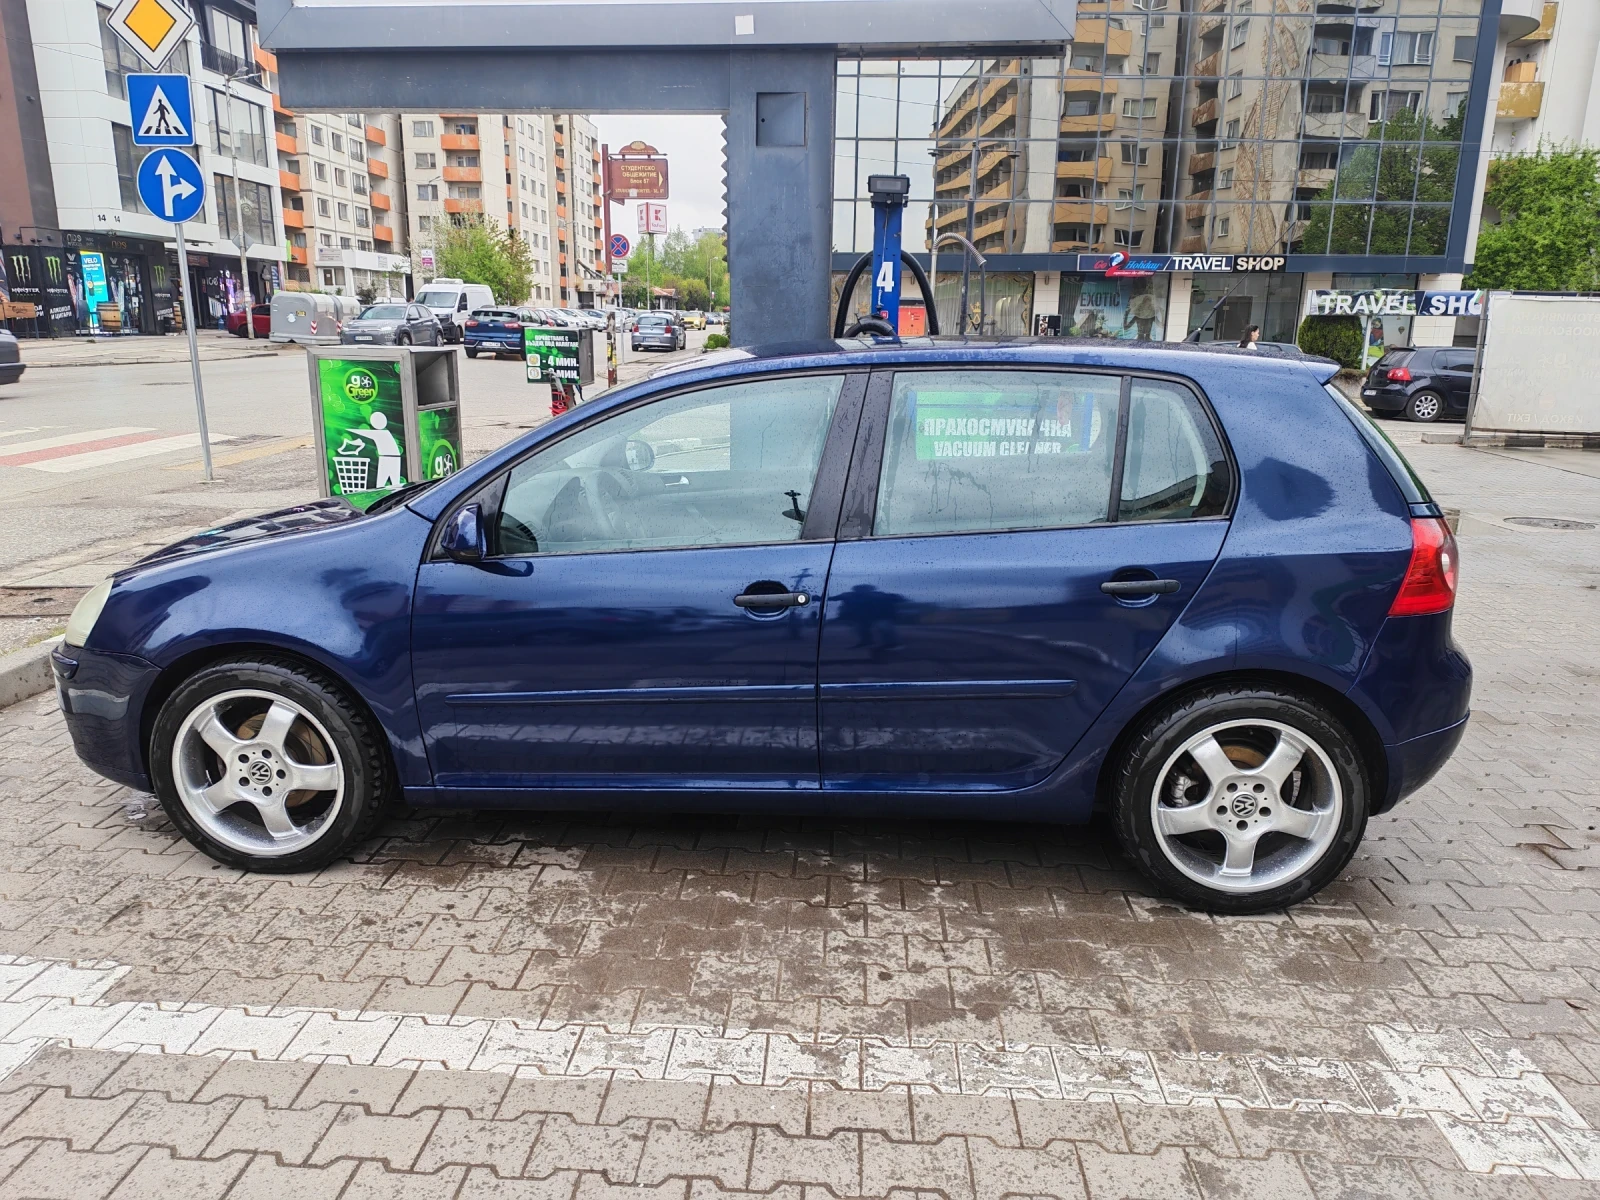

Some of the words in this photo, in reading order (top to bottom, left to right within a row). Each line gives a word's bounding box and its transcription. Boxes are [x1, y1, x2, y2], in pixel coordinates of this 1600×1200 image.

[97, 214, 107, 222] 14
[114, 215, 121, 223] 14
[1125, 260, 1161, 271] Holiday
[1172, 256, 1231, 270] TRAVEL
[1236, 256, 1285, 271] SHOP
[876, 261, 895, 293] 4
[1080, 292, 1121, 307] EXOTIC
[1321, 295, 1416, 315] TRAVEL
[1429, 295, 1483, 316] SHO
[548, 355, 555, 367] 4
[555, 357, 580, 367] МИН.
[345, 383, 376, 397] Green
[933, 440, 996, 457] VACUUM
